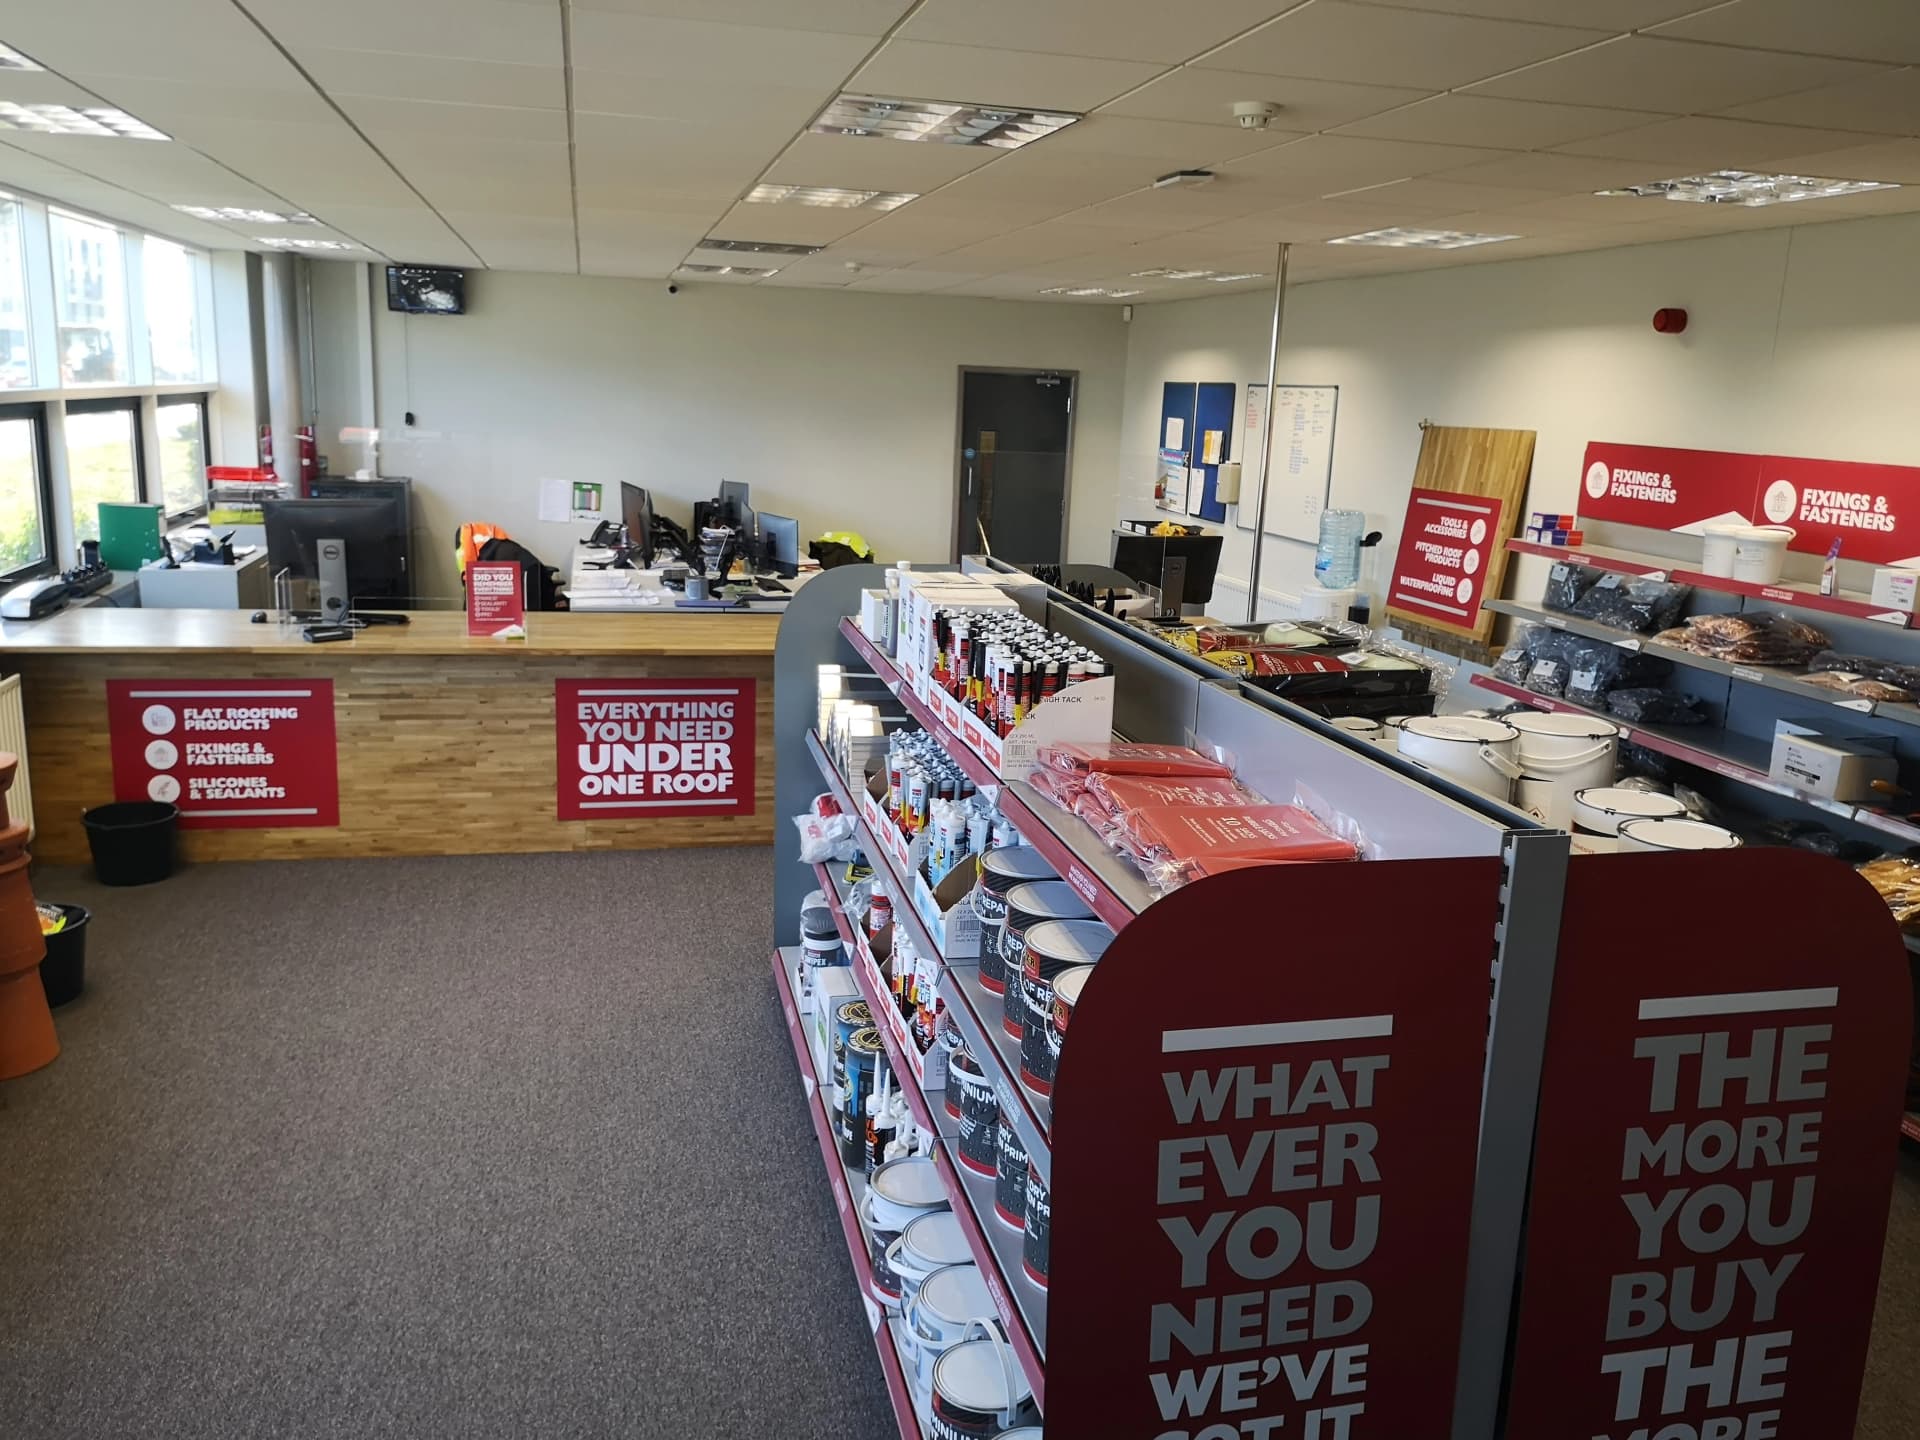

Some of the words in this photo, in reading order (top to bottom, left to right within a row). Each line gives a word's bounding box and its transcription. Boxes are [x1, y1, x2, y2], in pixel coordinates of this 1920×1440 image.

[1612, 468, 1660, 486] FIXINGS
[1661, 474, 1672, 488] &
[1610, 482, 1677, 504] FASTENERS
[1802, 488, 1870, 512] FIXINGS
[1873, 496, 1888, 514] &
[1440, 516, 1461, 529] TOOLS
[1800, 504, 1896, 532] FASTENERS
[1424, 523, 1467, 539] ACCESSORIES
[1415, 541, 1442, 556] PITCHED
[1443, 546, 1463, 558] ROOF
[1425, 553, 1460, 568] PRODUCTS
[474, 573, 492, 581] DID
[493, 573, 513, 581] YOU
[1400, 575, 1454, 597] WATERPROOFING
[1432, 573, 1456, 586] LIQUID
[183, 708, 223, 719] FLAT
[227, 707, 298, 719] ROOFING
[577, 702, 734, 720] EVERYTHING
[184, 719, 270, 731] PRODUCTS
[579, 721, 645, 742] YOU
[655, 721, 734, 741] NEED
[186, 743, 249, 754] FIXINGS
[253, 743, 265, 754] &
[187, 753, 274, 766] FASTENERS
[578, 742, 733, 773] UNDER
[189, 777, 267, 789] SILICONES
[190, 789, 200, 800] &
[206, 787, 285, 800] SEALANTS
[579, 774, 644, 796] ONE
[653, 772, 734, 794] ROOF
[1633, 1024, 1832, 1112] THE
[1161, 1055, 1390, 1124] WHAT
[1621, 1112, 1822, 1180] MORE
[1157, 1121, 1382, 1204] EVER
[1621, 1175, 1816, 1260] YOU
[1157, 1195, 1381, 1288] YOU
[1604, 1253, 1804, 1341] BUY
[1150, 1280, 1373, 1362] NEED
[1149, 1344, 1369, 1421] WE'VE
[1600, 1330, 1793, 1421] THE
